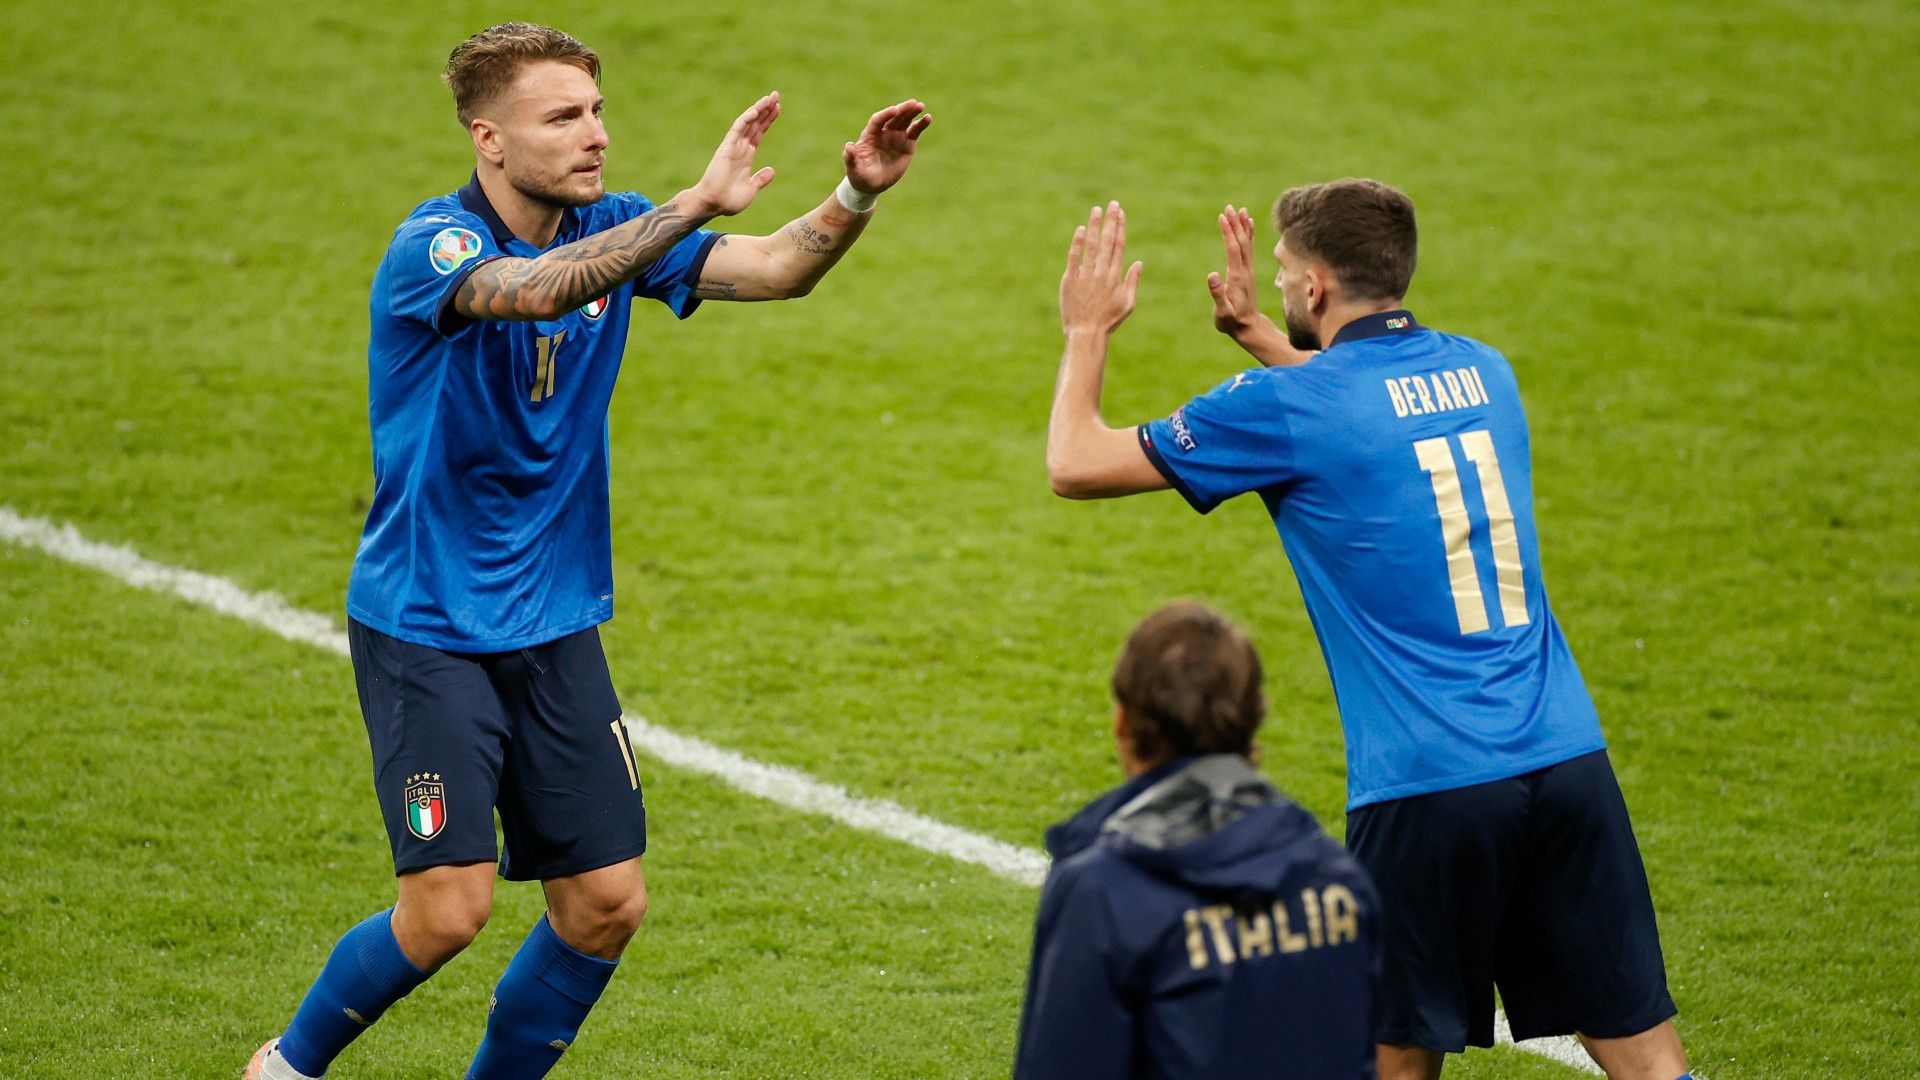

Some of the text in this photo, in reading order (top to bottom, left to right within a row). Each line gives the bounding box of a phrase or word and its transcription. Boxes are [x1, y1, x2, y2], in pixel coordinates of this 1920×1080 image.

[1384, 366, 1490, 418] BERARDI
[1413, 429, 1531, 636] 11
[408, 786, 440, 799] ITALIA
[1183, 882, 1359, 971] ITALIA
